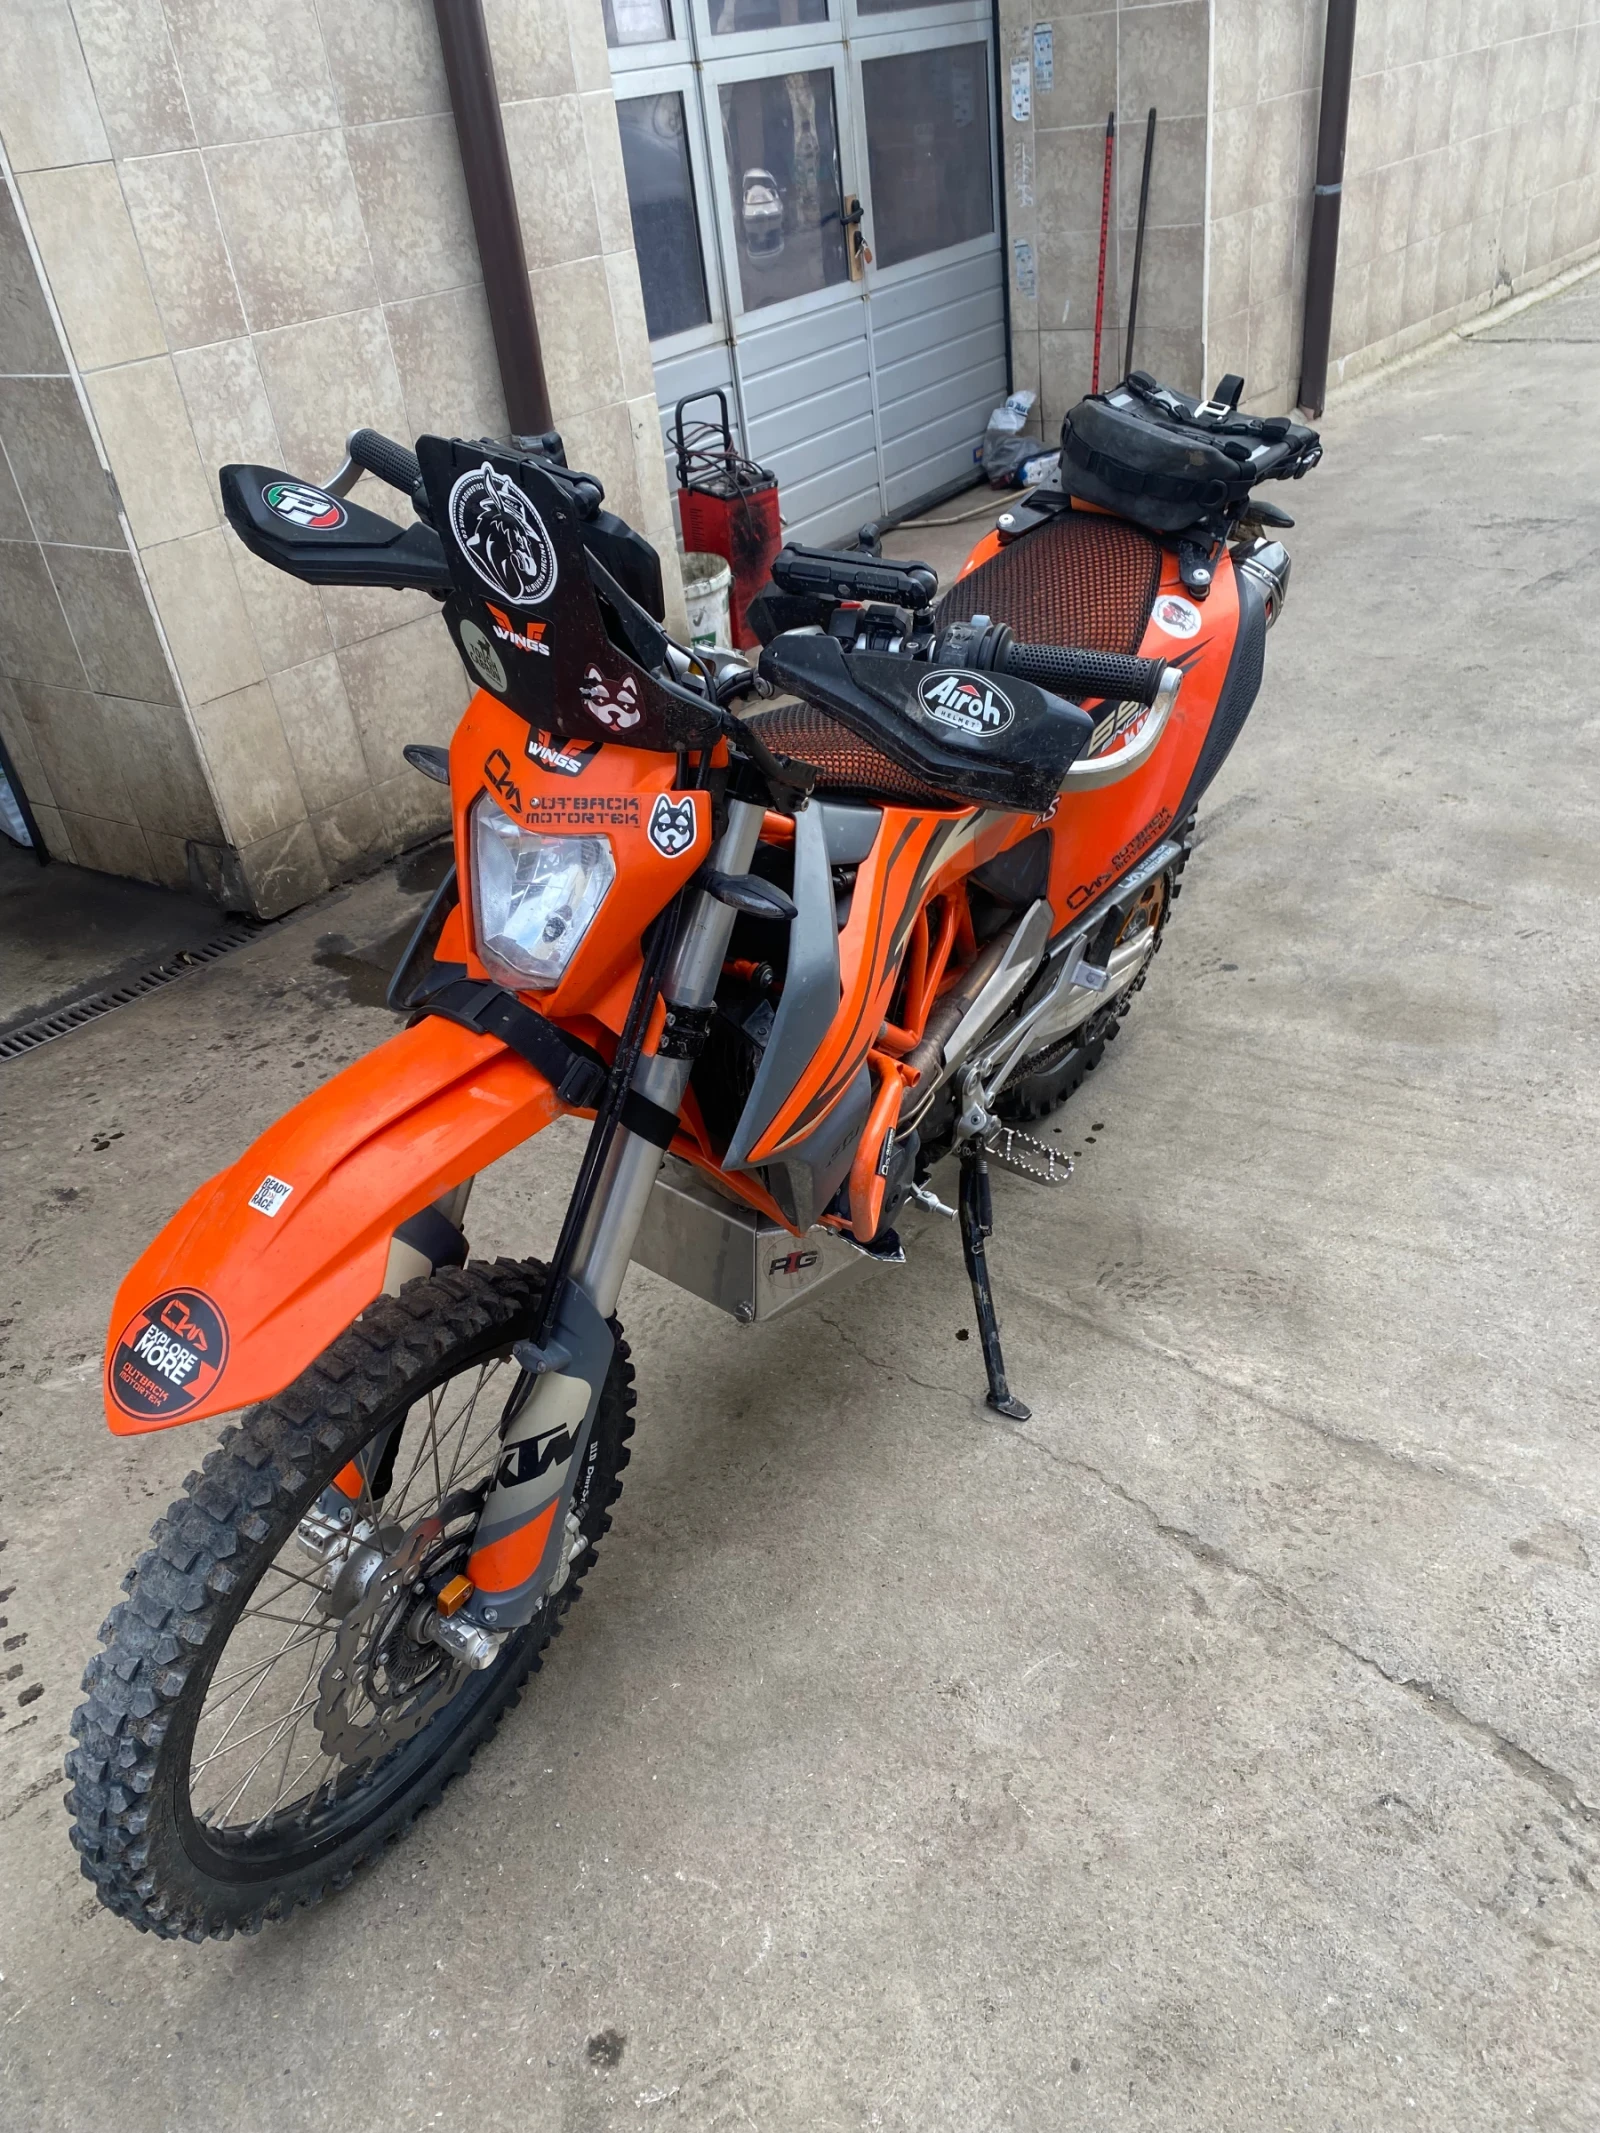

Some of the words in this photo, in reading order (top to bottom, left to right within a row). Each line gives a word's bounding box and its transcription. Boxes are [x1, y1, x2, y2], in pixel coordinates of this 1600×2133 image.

[539, 543, 547, 574] RACING
[493, 625, 550, 656] WINGS
[924, 676, 1000, 726] Airoh
[940, 710, 976, 728] HELMET
[528, 741, 582, 773] WINGS
[526, 812, 639, 825] MOTORTEK
[530, 797, 639, 811] UTBACK
[1111, 806, 1168, 865] OUTBACK
[1115, 813, 1172, 871] MOTORTEK
[251, 1194, 274, 1211] RACE
[257, 1186, 269, 1197] TO
[261, 1178, 291, 1196] READY
[133, 1333, 186, 1386] MORE
[143, 1324, 198, 1372] EXPLORE
[119, 1370, 163, 1407] MOTORTEK
[122, 1362, 169, 1401] OUTBACK
[490, 1418, 585, 1492] KTM
